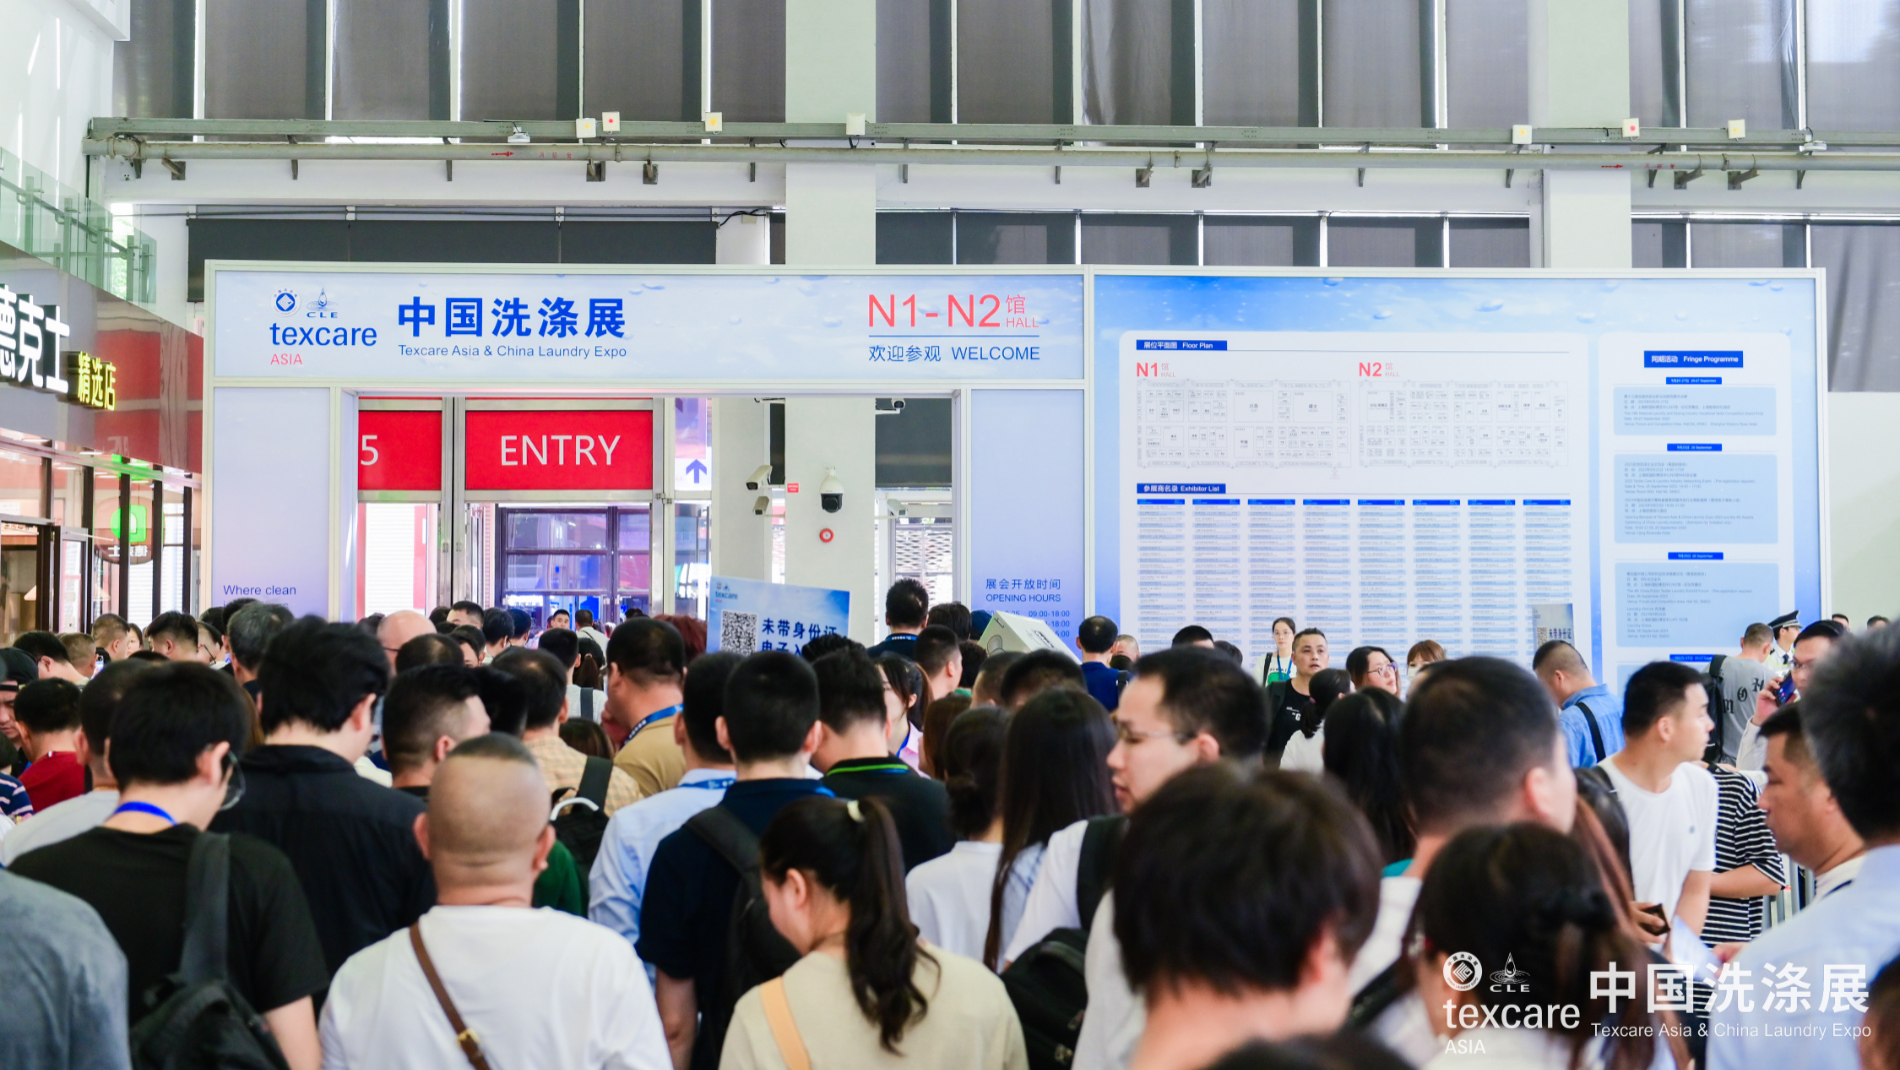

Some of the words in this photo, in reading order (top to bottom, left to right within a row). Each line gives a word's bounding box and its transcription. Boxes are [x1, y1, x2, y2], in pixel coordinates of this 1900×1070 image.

[1006, 294, 1026, 315] 馆
[306, 311, 338, 319] CLE
[398, 296, 626, 339] 中国洗涤展
[1006, 318, 1039, 328] HALL
[0, 284, 70, 393] 德克士
[269, 324, 378, 347] texcare
[270, 354, 303, 366] ASIA
[398, 345, 449, 357] Texcare
[452, 345, 480, 357] Asia
[484, 345, 493, 357] &
[496, 345, 534, 357] China
[538, 345, 590, 360] Laundry
[594, 346, 627, 360] Expo
[868, 345, 941, 362] 欢迎参观
[952, 347, 1040, 360] WELCOME
[1684, 356, 1702, 364] Fringe
[1704, 356, 1739, 364] Programme
[1136, 362, 1158, 377] N1
[1359, 362, 1382, 377] N2
[78, 350, 116, 411] 精选店
[360, 435, 379, 466] 5
[500, 435, 621, 466] ENTRY
[223, 585, 262, 595] Where
[266, 585, 297, 595] clean
[986, 578, 1061, 590] 展会开放时间
[986, 594, 1027, 603] OPENING
[1029, 594, 1061, 603] HOURS
